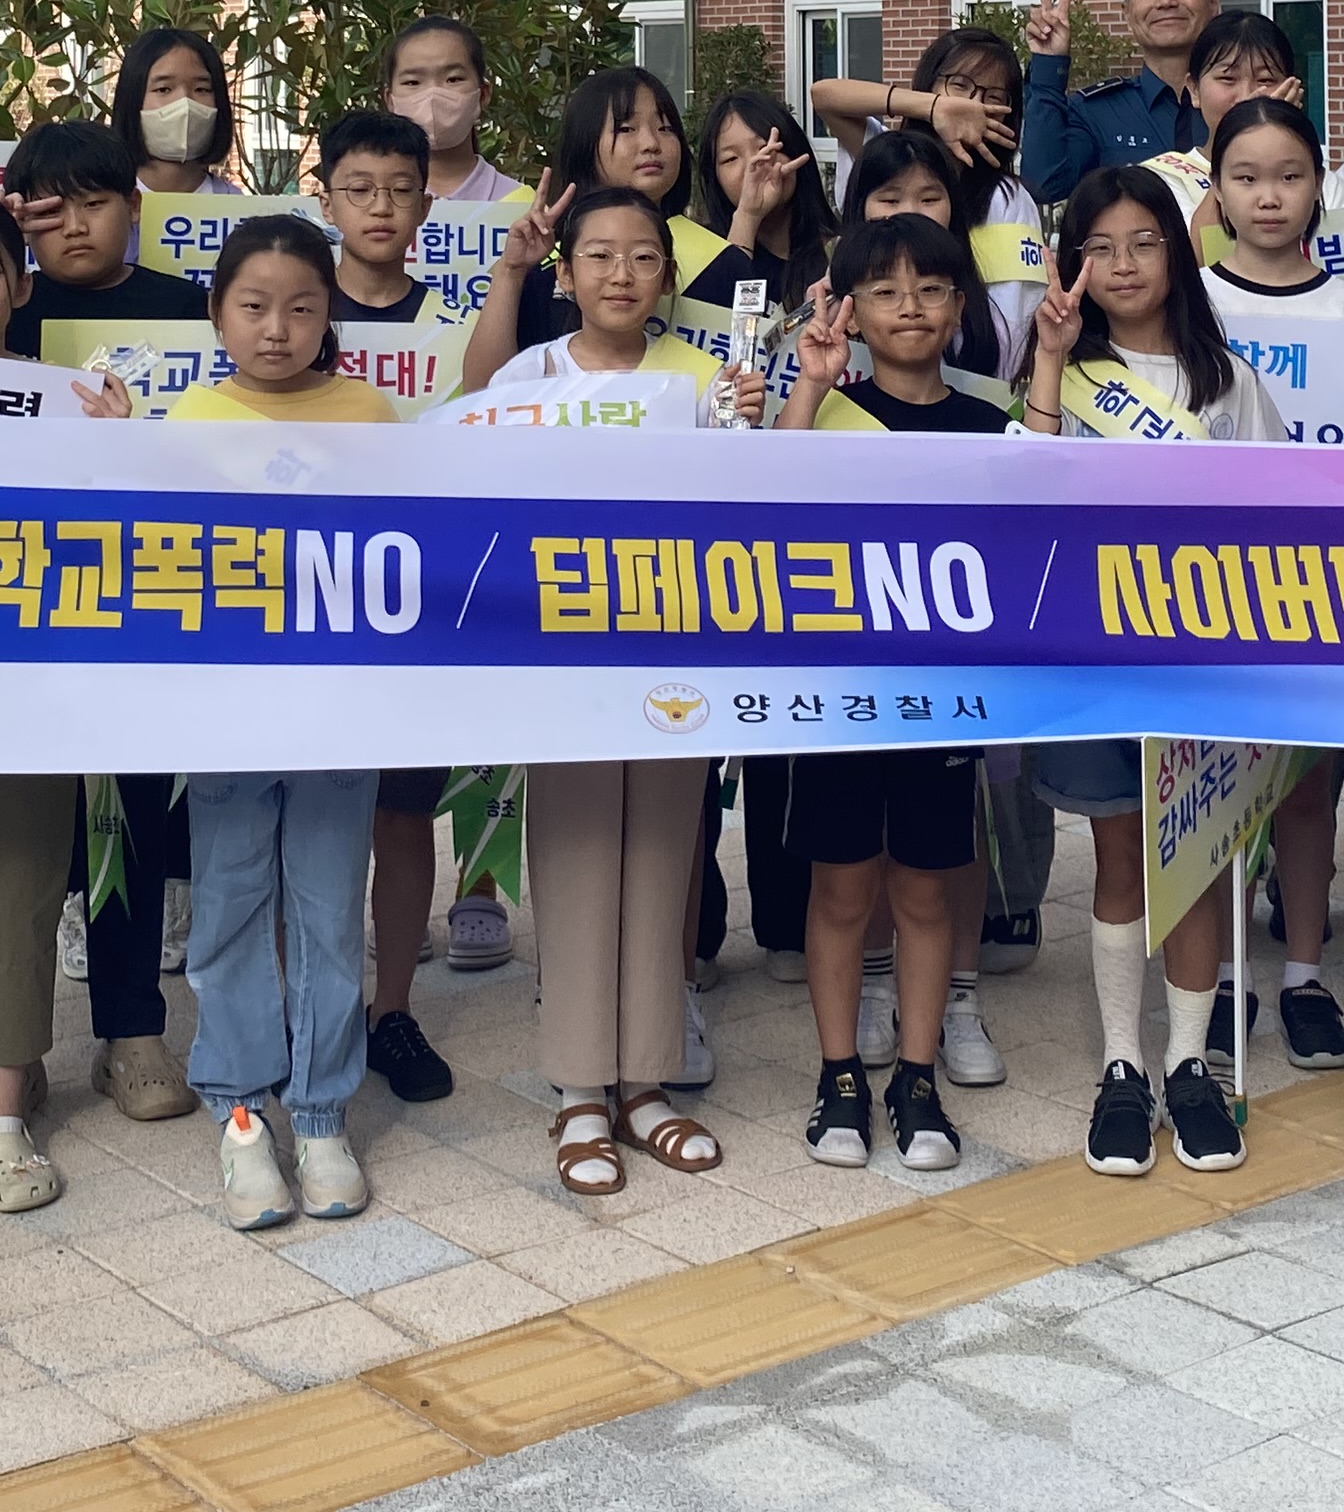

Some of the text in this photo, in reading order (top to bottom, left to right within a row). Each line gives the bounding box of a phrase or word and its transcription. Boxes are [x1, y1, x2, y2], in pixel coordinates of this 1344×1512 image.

[160, 216, 248, 260] 우리
[529, 536, 995, 634] 딥페이크NO
[732, 692, 989, 724] 양산경찰서
